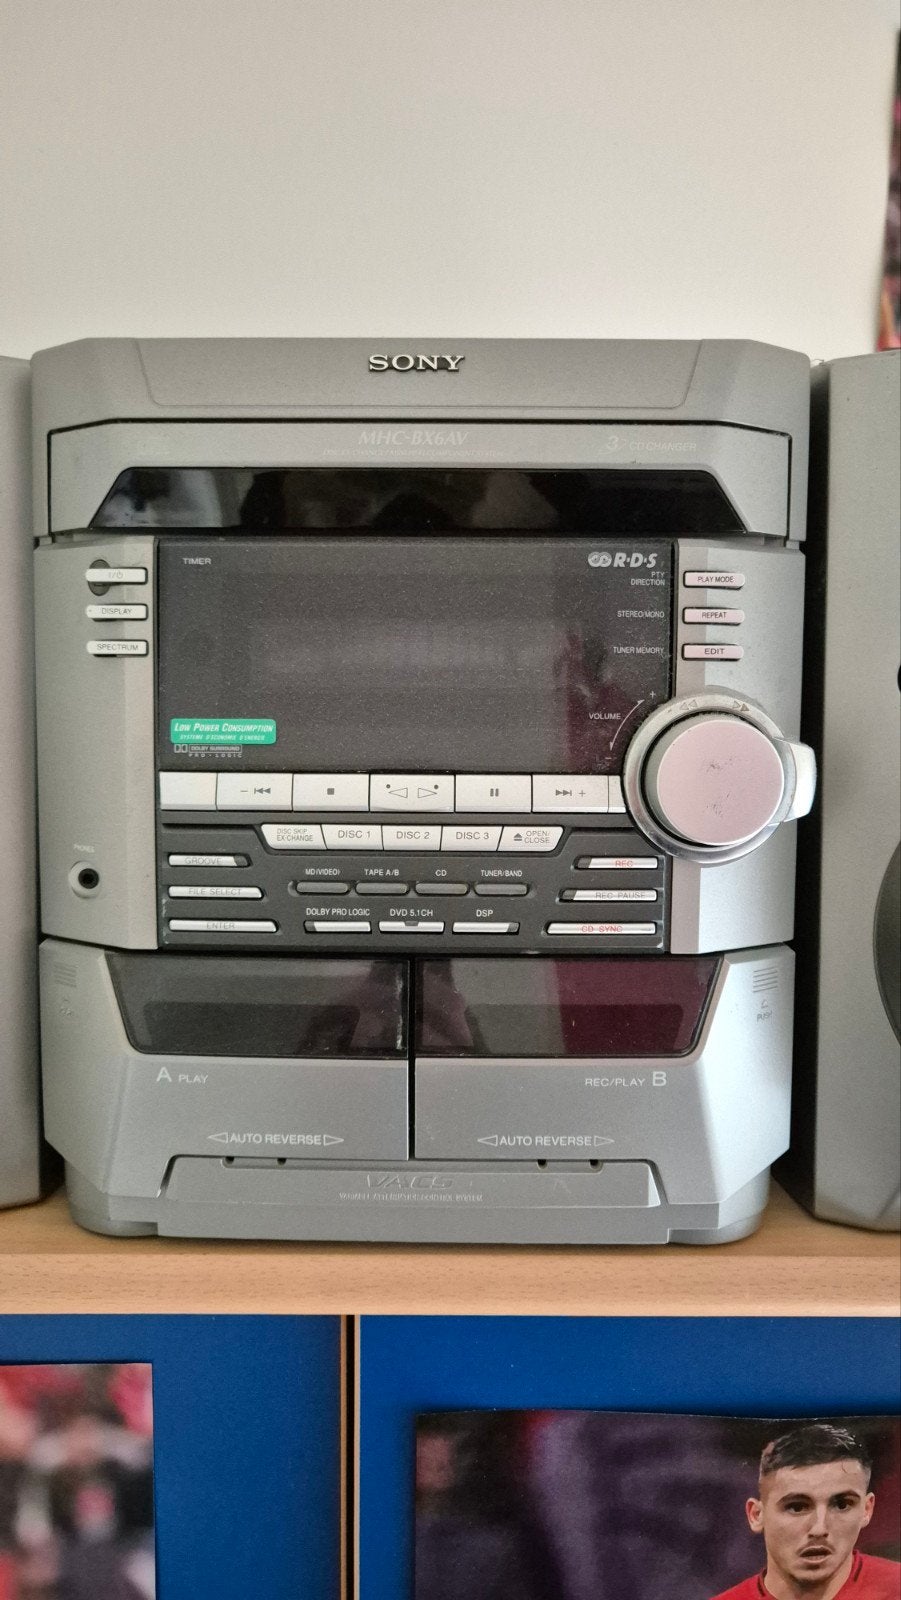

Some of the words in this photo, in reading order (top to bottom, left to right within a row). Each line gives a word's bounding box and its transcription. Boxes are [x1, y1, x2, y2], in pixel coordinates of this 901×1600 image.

[368, 354, 465, 372] SONY
[359, 430, 469, 446] MHC-BX6AV
[645, 441, 697, 452] CHANGER
[182, 557, 212, 565] TIMER
[630, 578, 665, 586] DIRECTION
[697, 575, 714, 583] PLAY
[715, 575, 734, 583] MODE
[101, 607, 132, 615] DISPLAY
[617, 610, 665, 619] STEREO/MONO
[701, 611, 727, 619] REPEAT
[96, 643, 139, 651] SPECTRUM
[613, 646, 635, 654] TUNER
[635, 646, 665, 654] MEMORY
[704, 647, 725, 655] EDIT
[588, 712, 621, 720] VOLUME
[338, 830, 363, 839] DISC
[366, 830, 372, 839] 1
[396, 831, 422, 840] DISC
[423, 831, 430, 840] 2
[455, 831, 481, 840] DISC
[482, 831, 490, 840] 3
[184, 857, 222, 865] GROOVE
[364, 869, 384, 877] TAPE
[386, 869, 400, 877] A/B
[480, 869, 523, 877] TUNER/BAND
[188, 888, 205, 896] FILE
[209, 888, 242, 896] SELECT
[306, 908, 330, 916] DOLBY
[331, 908, 348, 916] PRO
[348, 908, 371, 916] LOGIC
[389, 908, 408, 917] DVD
[409, 908, 433, 917] 5.1CH
[475, 909, 494, 917] DSP
[581, 925, 594, 933] CD
[599, 925, 623, 933] SYNC
[156, 1066, 173, 1083] A
[178, 1074, 209, 1083] PLAY
[584, 1078, 646, 1087] REC/PLAY
[652, 1071, 667, 1087] B
[230, 1133, 262, 1144] AUTO
[264, 1134, 322, 1146] REVERSE
[500, 1135, 533, 1146] AUTO
[535, 1136, 592, 1147] REVERSE
